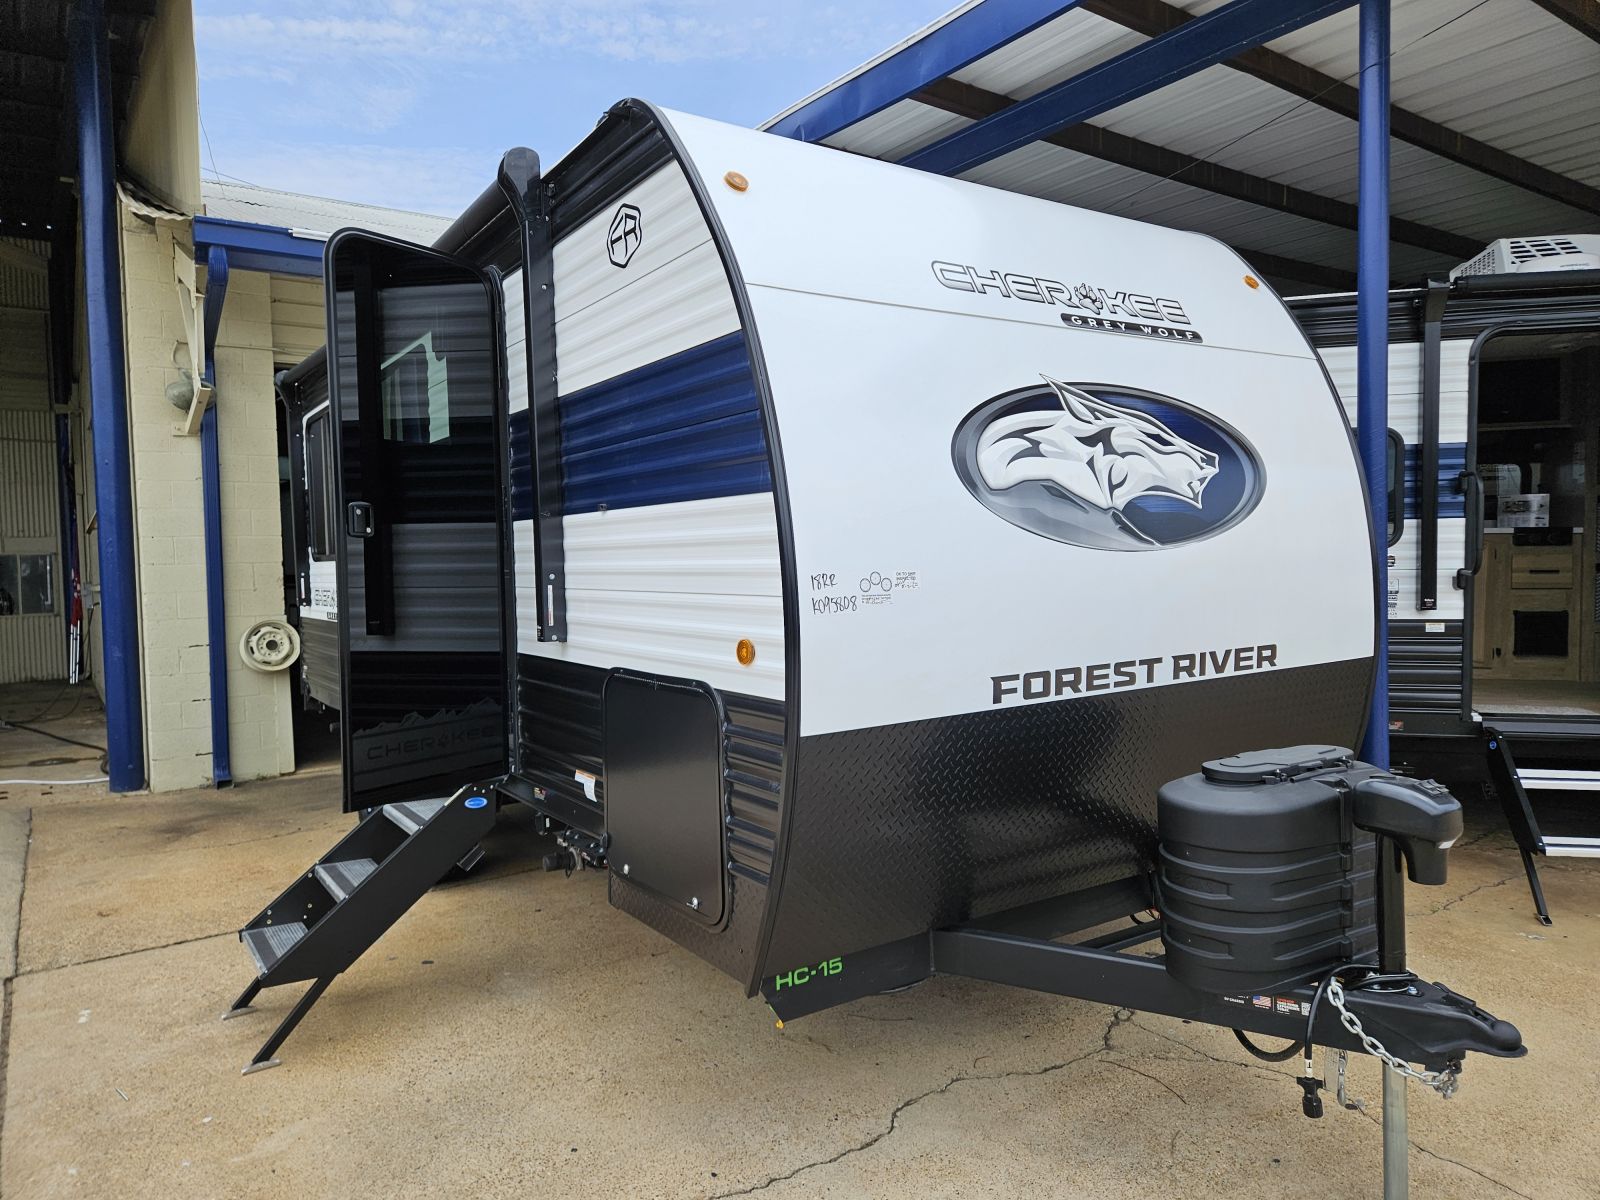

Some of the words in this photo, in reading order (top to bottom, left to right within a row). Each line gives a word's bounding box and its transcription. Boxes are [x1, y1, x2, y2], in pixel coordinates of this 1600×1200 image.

[1070, 315, 1127, 331] GREY
[1140, 324, 1195, 341] WOLF
[990, 657, 1163, 705] FOREST
[1171, 643, 1278, 681] RIVER
[775, 956, 843, 991] HC-15
